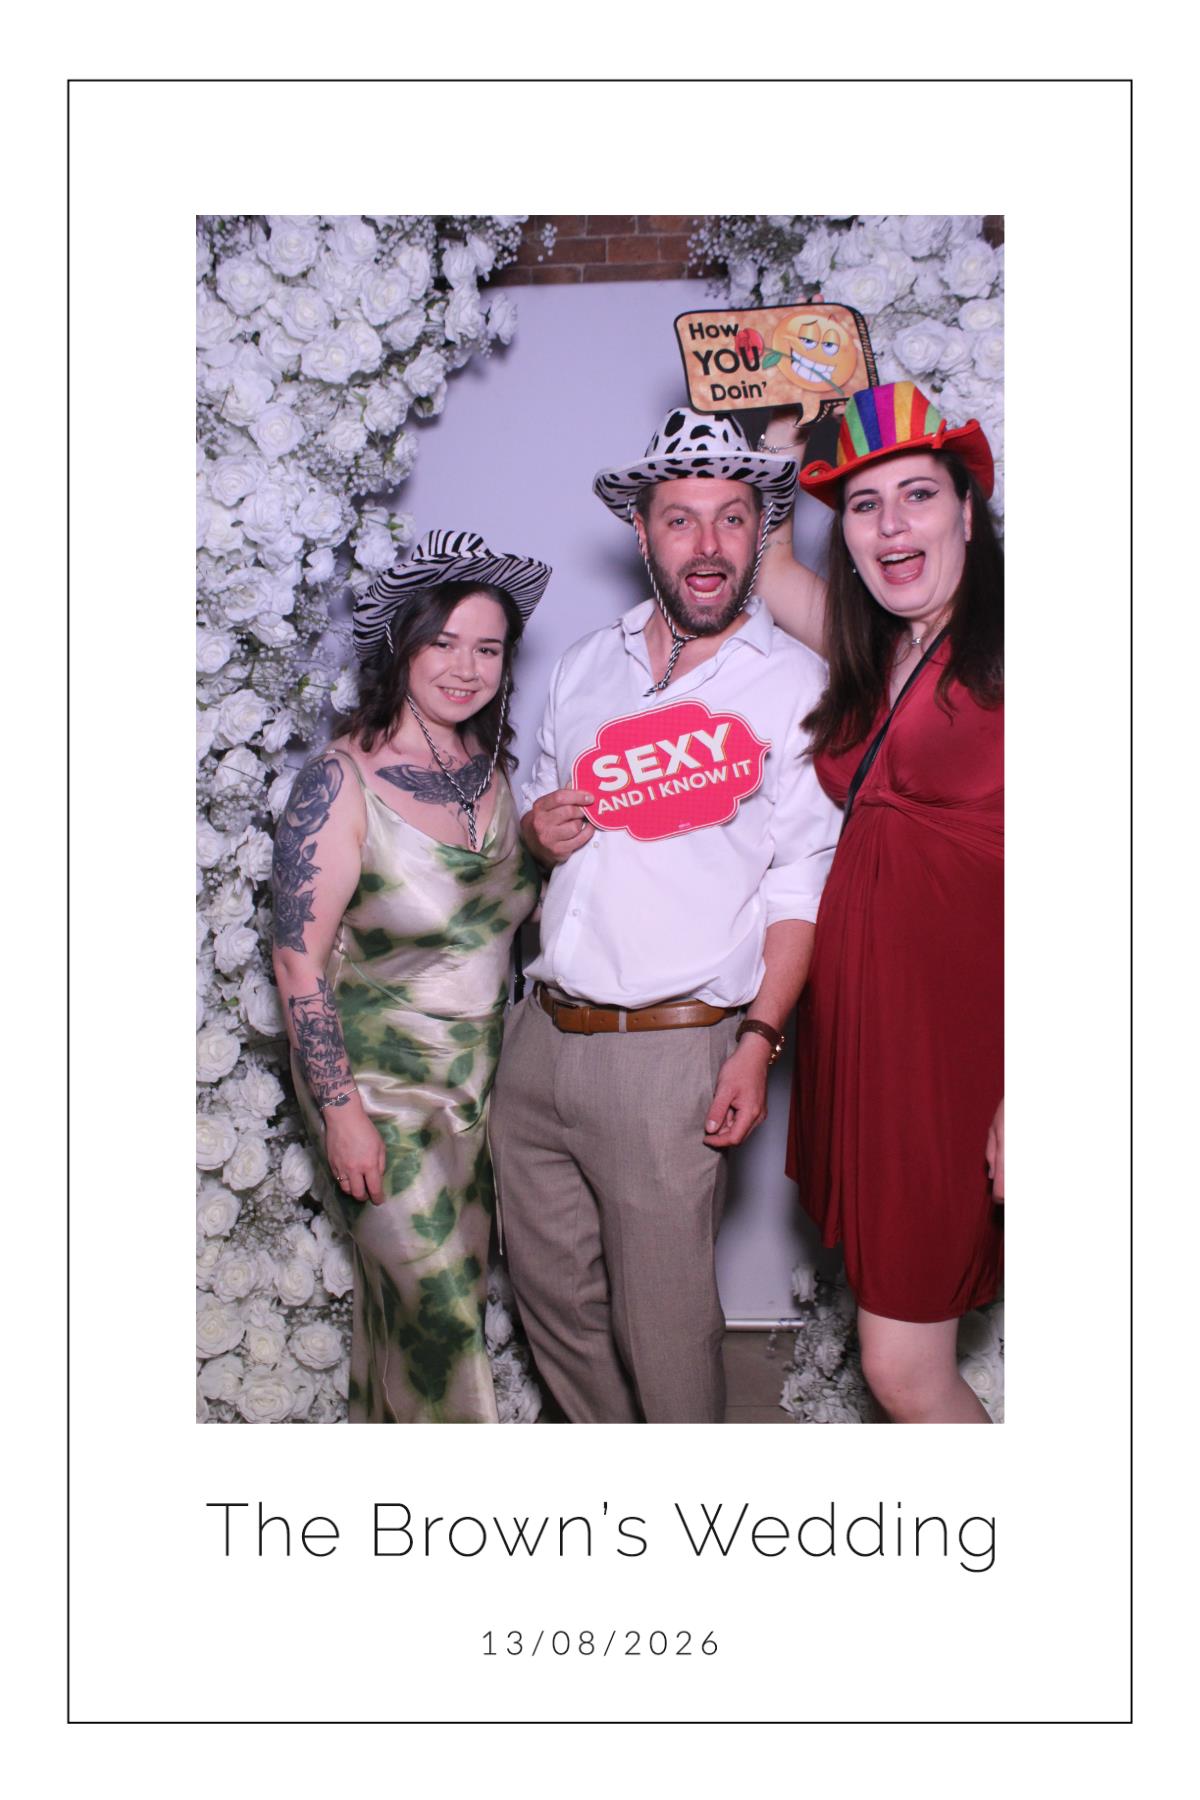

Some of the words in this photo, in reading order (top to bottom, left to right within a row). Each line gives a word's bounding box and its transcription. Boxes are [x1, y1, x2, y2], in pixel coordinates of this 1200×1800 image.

[689, 323, 739, 340] How
[693, 347, 760, 376] YOU
[711, 381, 767, 402] Doin'
[593, 723, 731, 791] SEXY
[598, 790, 645, 815] AND
[648, 787, 656, 801] I
[659, 766, 728, 797] KNOW
[733, 760, 752, 778] IT
